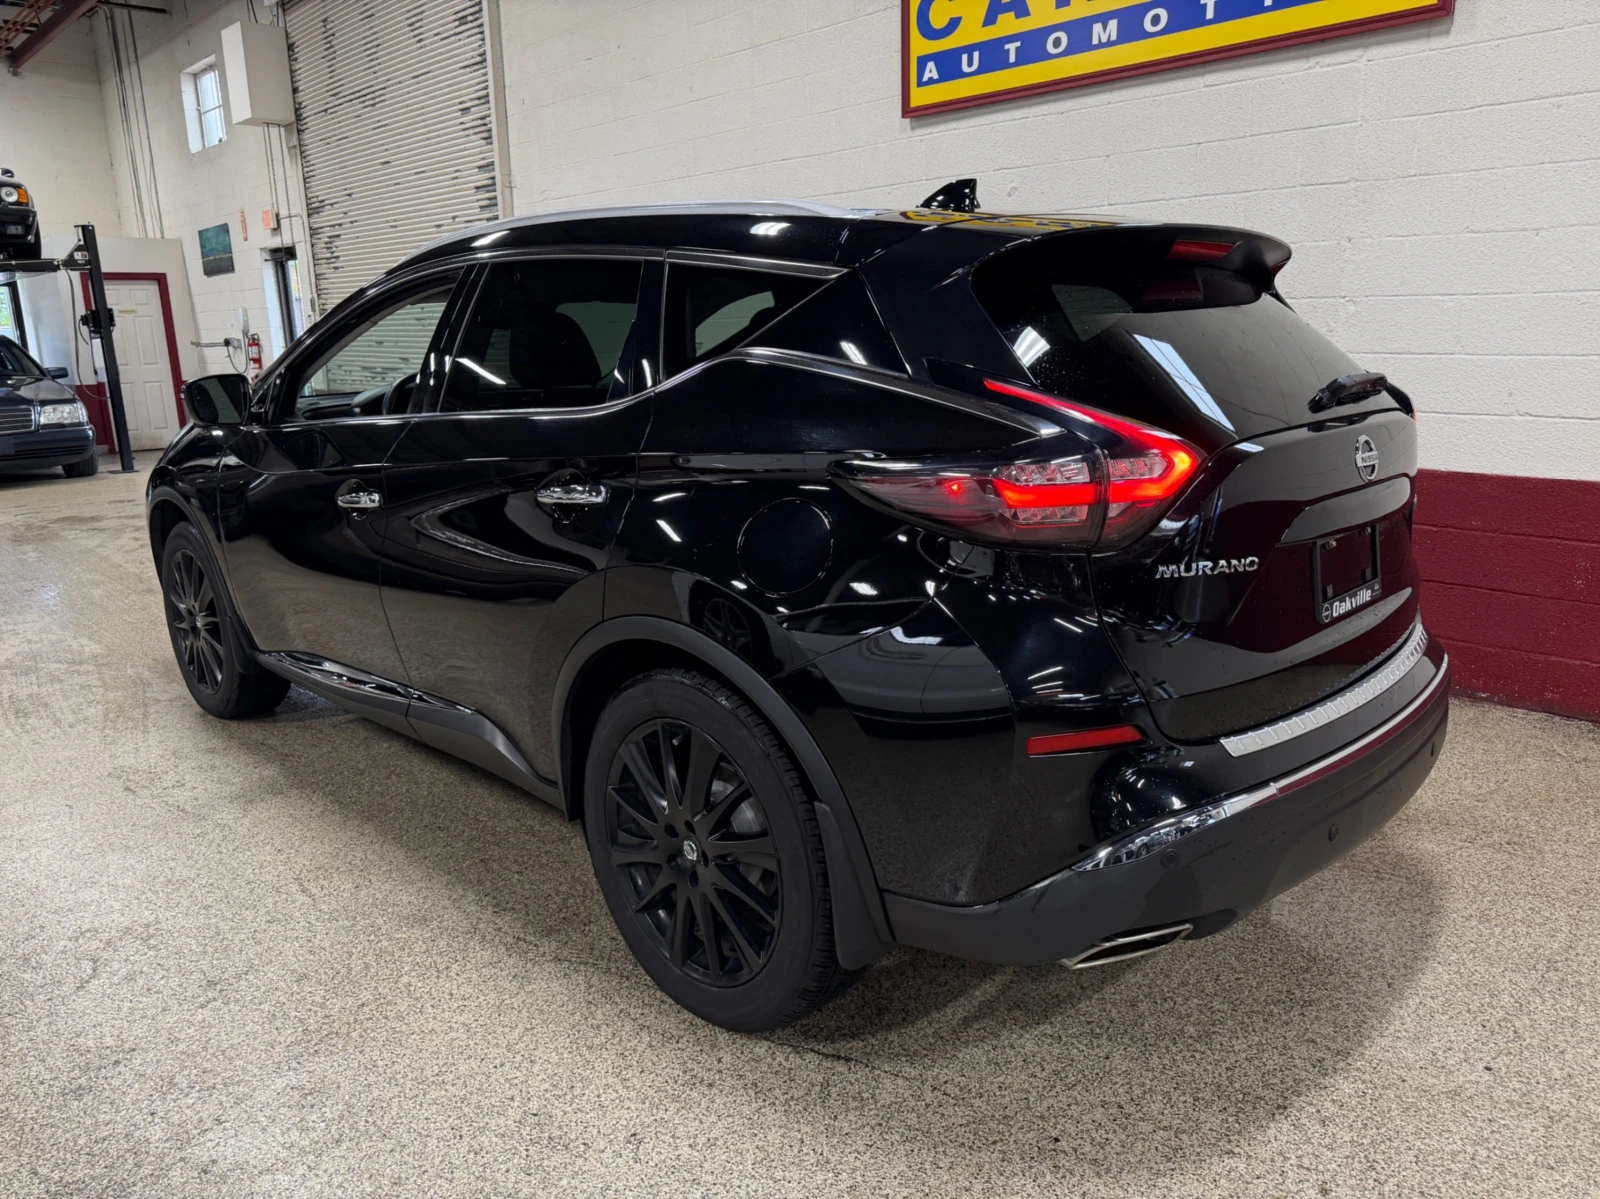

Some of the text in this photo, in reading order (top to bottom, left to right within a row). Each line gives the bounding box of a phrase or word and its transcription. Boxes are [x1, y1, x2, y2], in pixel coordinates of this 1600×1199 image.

[916, 0, 1096, 41] CA
[922, 0, 1273, 82] AUTOMOT
[1155, 557, 1259, 578] MURANO
[1332, 588, 1371, 617] Oakville
